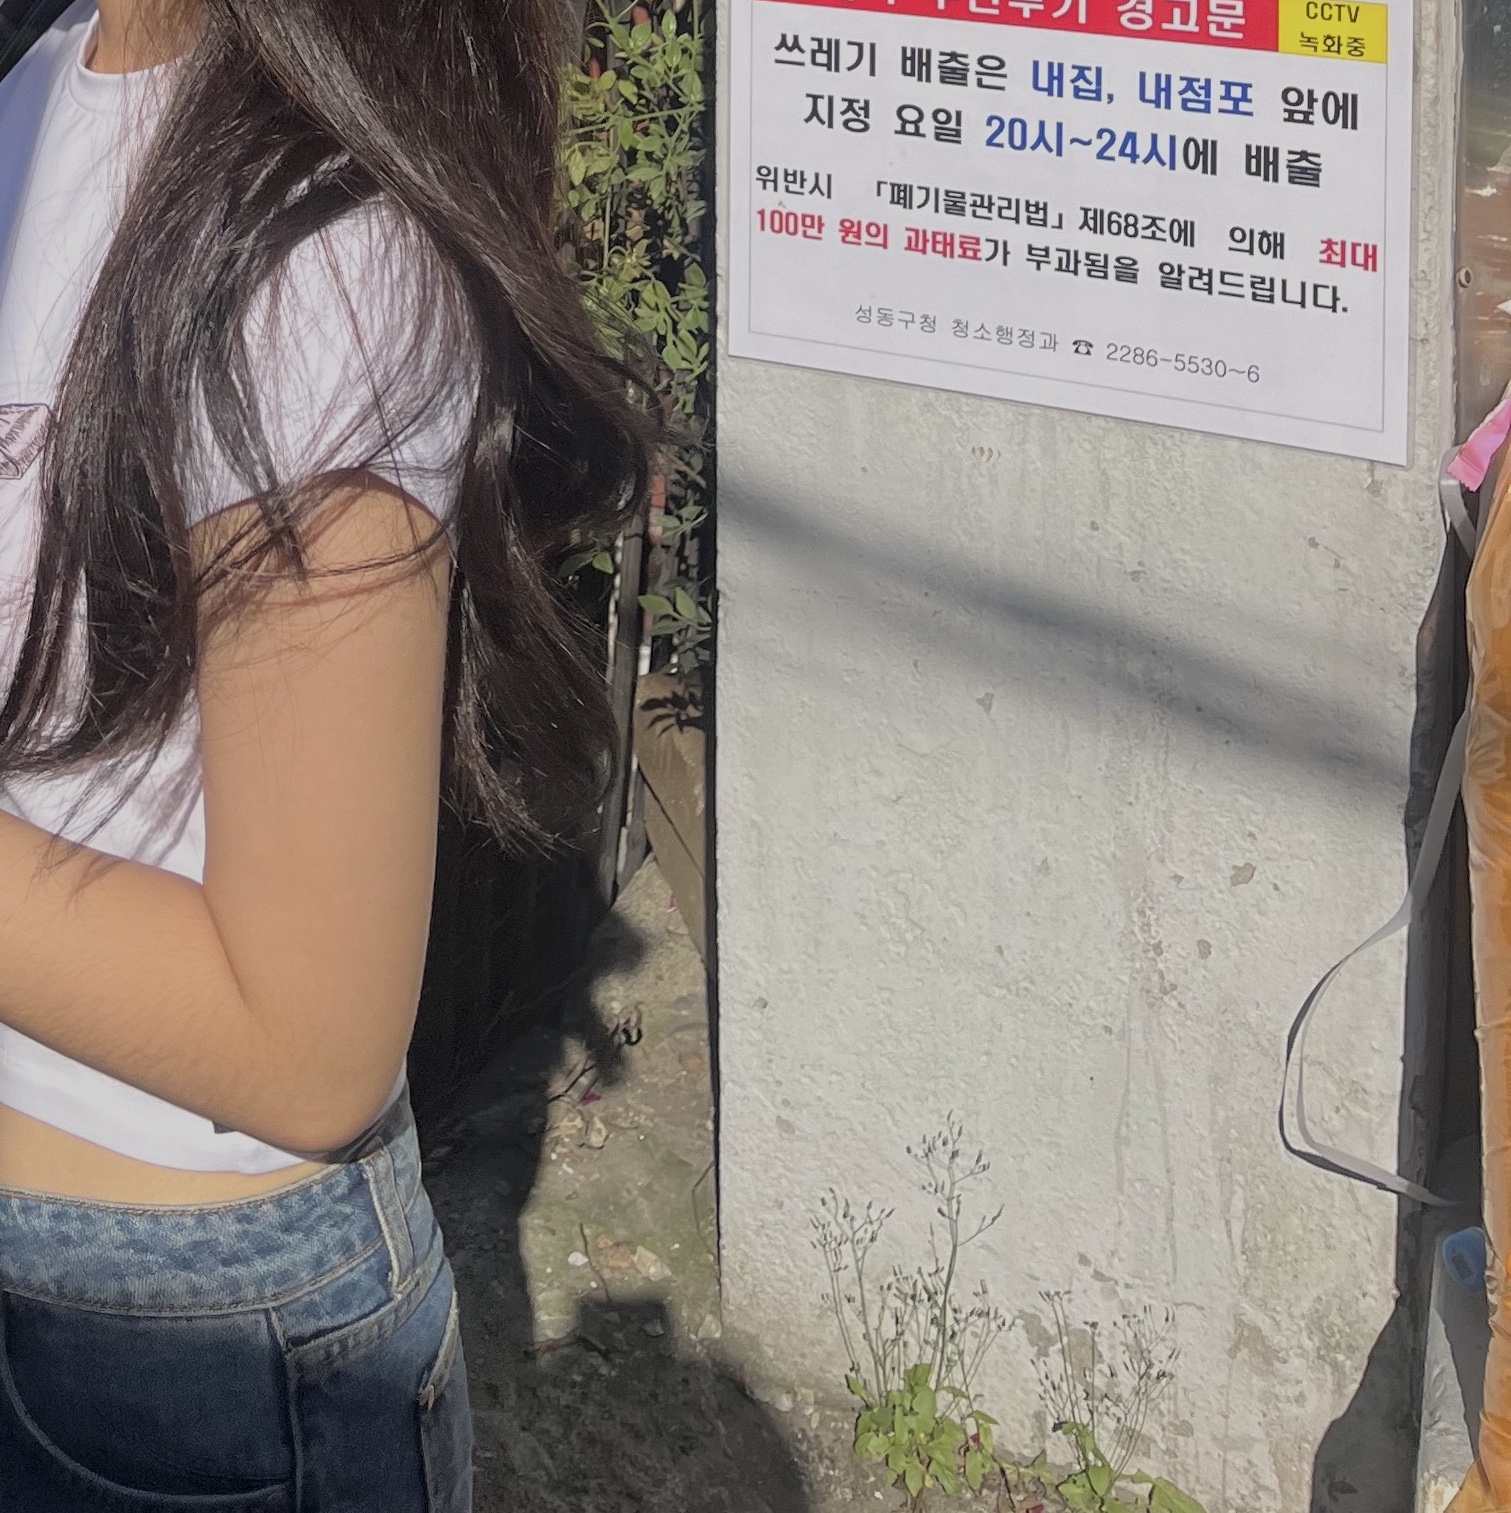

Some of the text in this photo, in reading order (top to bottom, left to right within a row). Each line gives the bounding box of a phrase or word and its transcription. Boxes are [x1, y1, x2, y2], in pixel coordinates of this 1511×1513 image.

[1298, 31, 1367, 58] 녹화중
[1305, 0, 1361, 23] CCTV
[774, 33, 1359, 130] 쓰레기 배출은 내집, 내점포 앞에
[803, 93, 1322, 188] 지정 요일 20시~24시에 배출
[756, 165, 833, 199] 위반시
[1228, 226, 1285, 260] 의해
[1319, 238, 1378, 272] 최대
[756, 208, 1348, 314] 100만 원의 과태료가 부과됨을 알려드립니다.
[855, 305, 1260, 383] 성동구청 청소행정과 2286-5530~6
